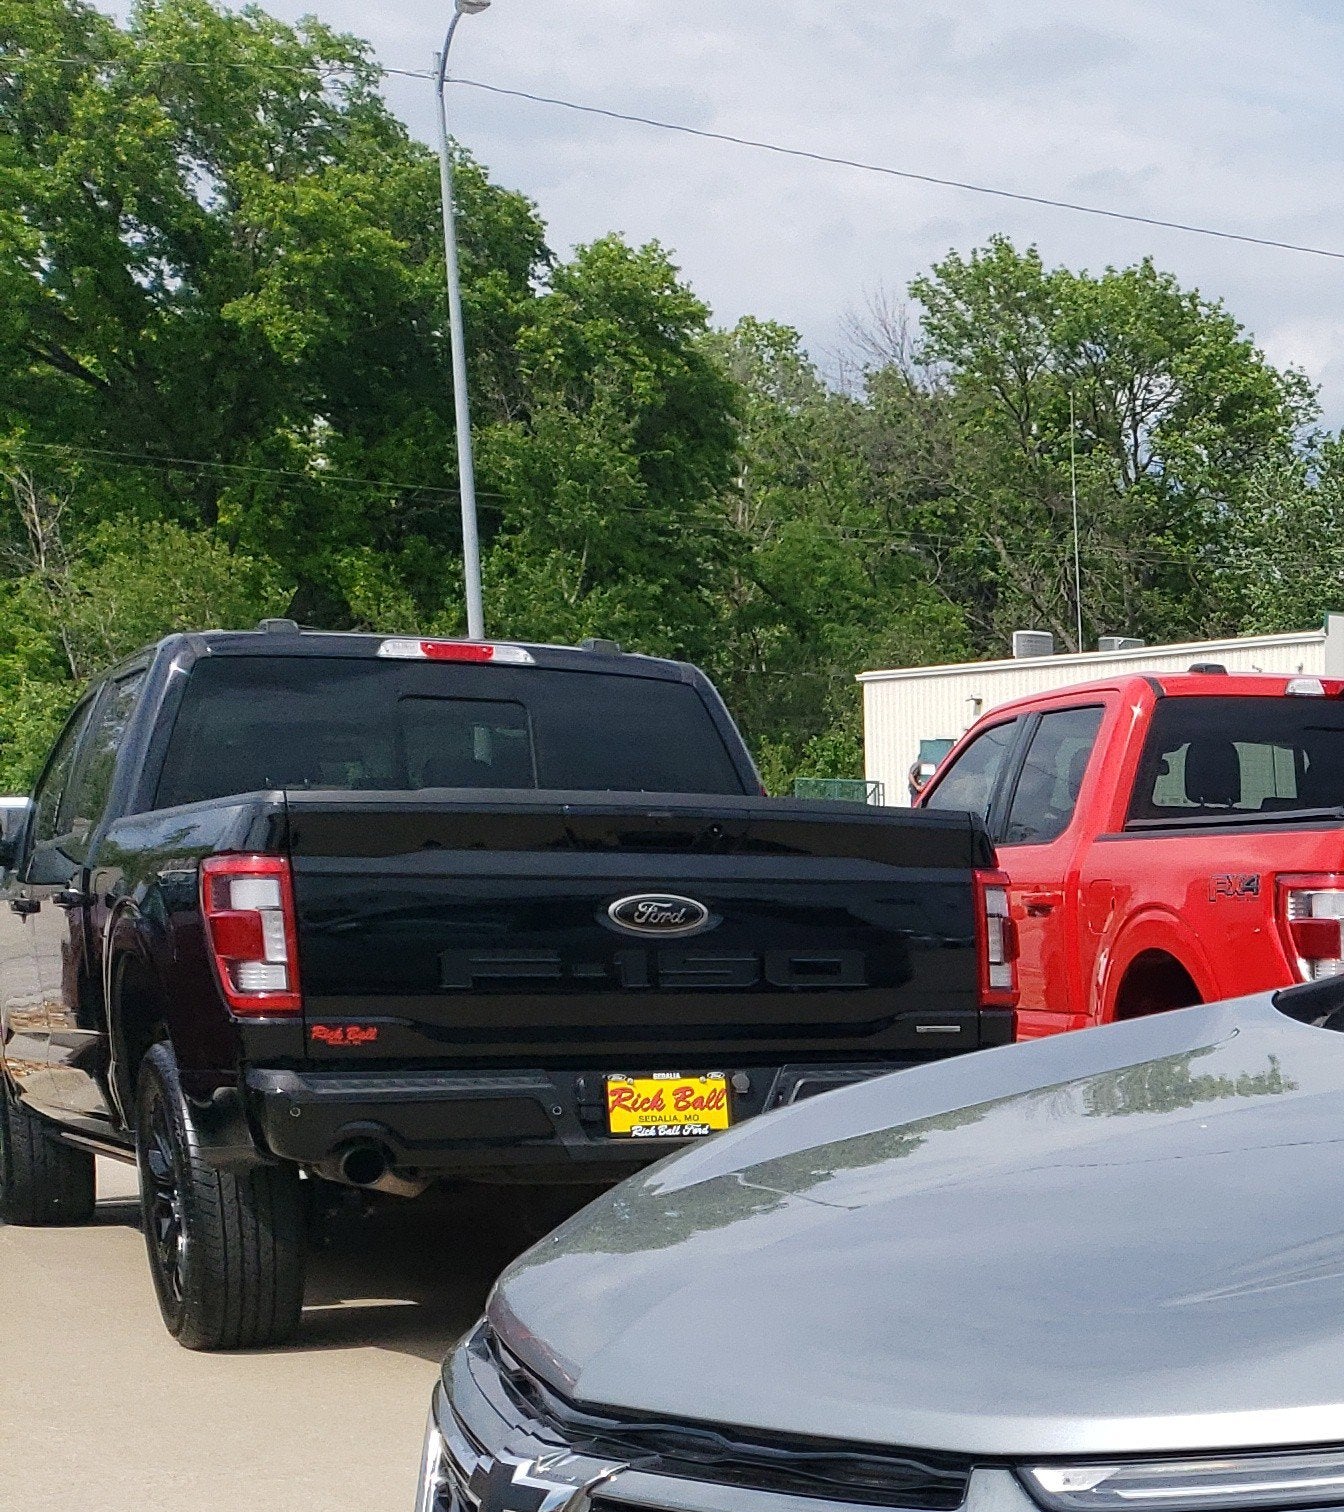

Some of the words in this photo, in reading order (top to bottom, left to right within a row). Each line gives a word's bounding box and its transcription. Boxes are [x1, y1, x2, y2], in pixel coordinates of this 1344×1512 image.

[1209, 874, 1260, 902] FX4
[633, 901, 686, 925] Ford
[439, 949, 868, 989] F-150
[609, 1087, 666, 1113] Rick
[672, 1086, 727, 1111] Ball
[631, 1126, 656, 1137] Rick
[658, 1125, 681, 1136] Ball
[682, 1124, 709, 1135] Ford
[684, 1114, 700, 1122] MO
